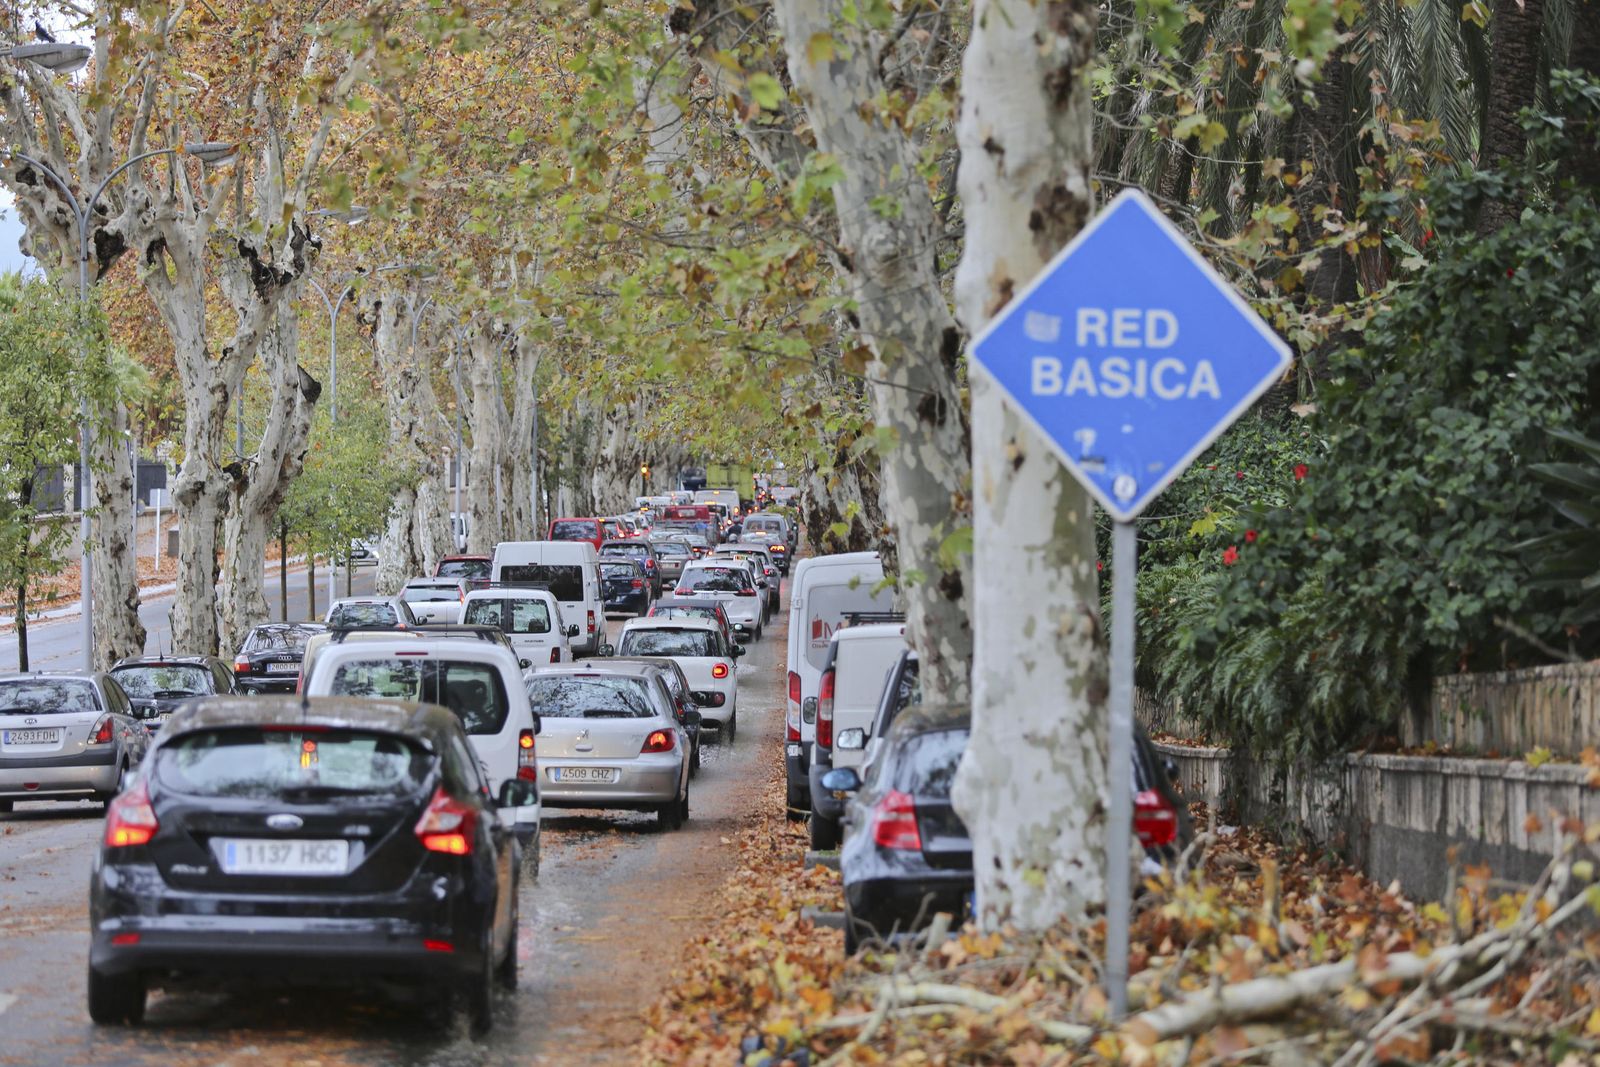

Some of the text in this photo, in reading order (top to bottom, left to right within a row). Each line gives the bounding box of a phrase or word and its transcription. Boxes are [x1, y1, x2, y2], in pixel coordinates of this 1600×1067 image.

[1076, 307, 1179, 348] RED
[1031, 357, 1222, 400] BASICA
[11, 731, 35, 742] 2493
[562, 768, 610, 780] 4509 CHZ
[245, 844, 339, 865] 1137 HGC
